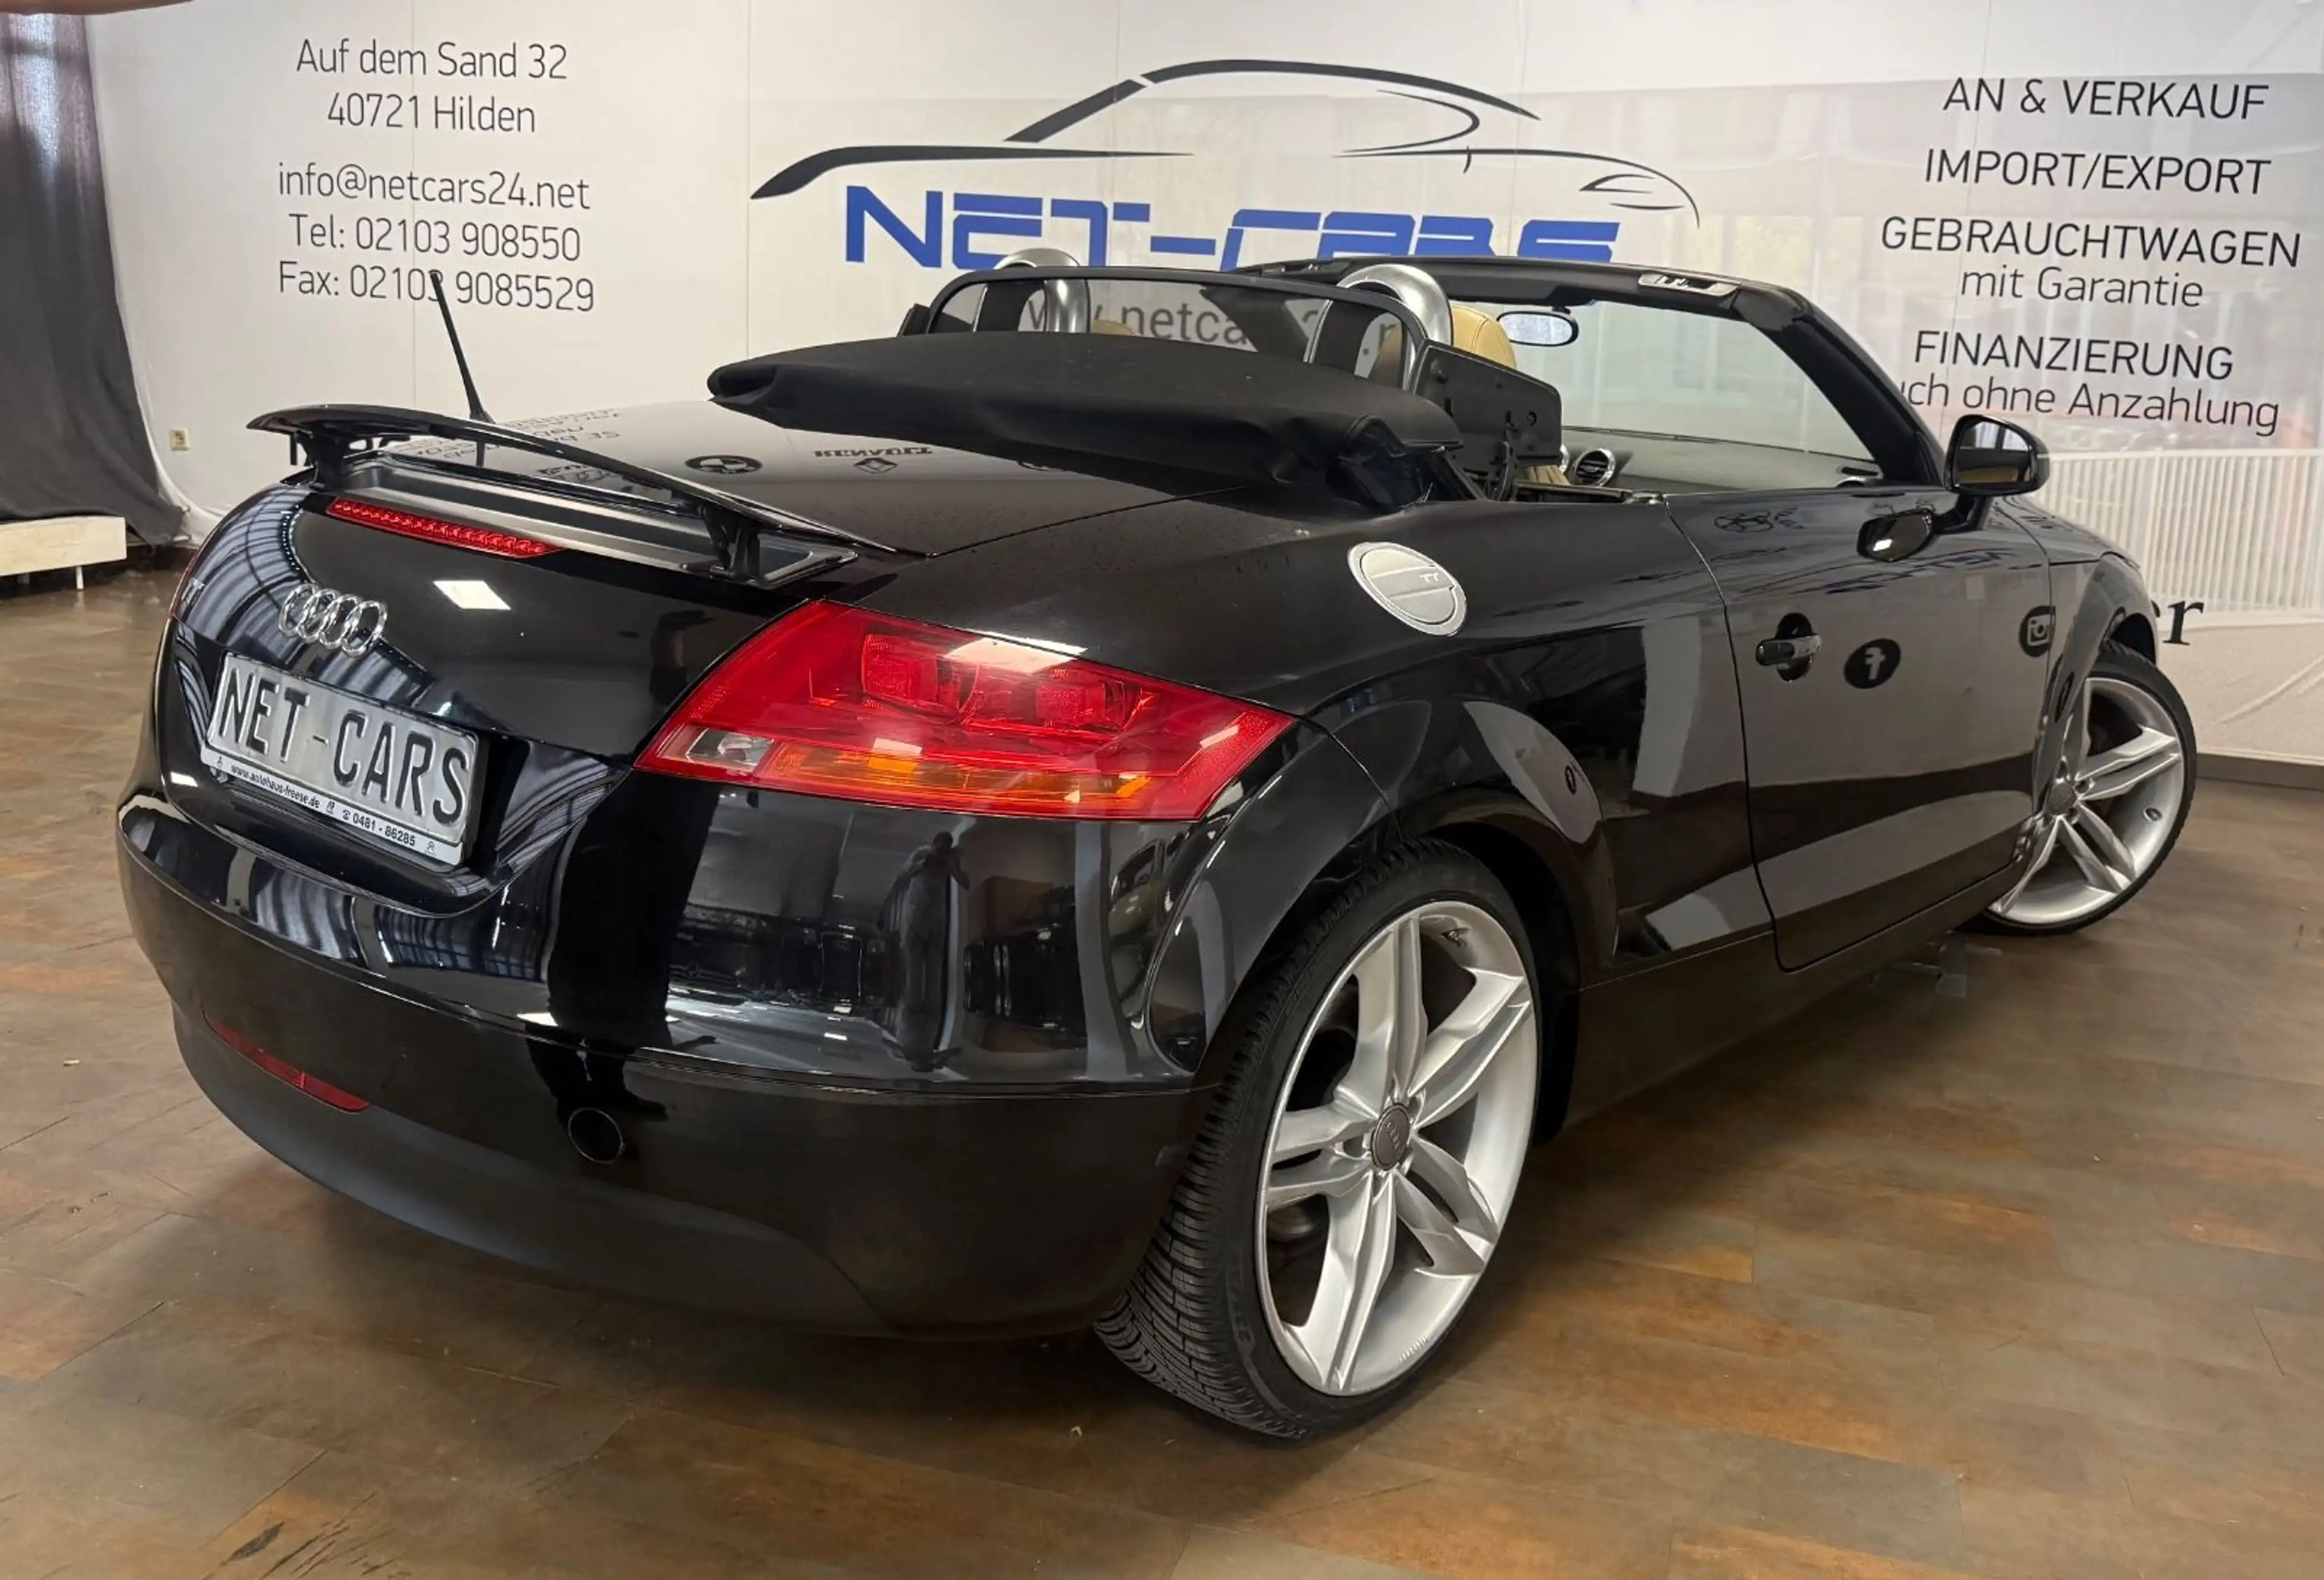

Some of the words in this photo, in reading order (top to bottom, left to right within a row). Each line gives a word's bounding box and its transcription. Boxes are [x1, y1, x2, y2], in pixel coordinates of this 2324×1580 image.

[297, 38, 349, 73] Auf
[359, 38, 426, 75] dem
[438, 42, 517, 77] Sand
[528, 44, 568, 79] 32
[327, 93, 419, 128] 40721
[434, 95, 536, 133] Hilden
[1943, 77, 2005, 112] AN
[2020, 78, 2046, 114] &
[2062, 79, 2270, 120] VERKAUF
[278, 162, 591, 209] info@netcars24.net
[1925, 148, 2272, 195] IMPORT/EXPORT
[289, 213, 345, 249] Tel:
[355, 216, 451, 254] 02103
[462, 221, 580, 261] 908550
[1881, 215, 2301, 268] GEBRAUCHTWAGEN
[280, 260, 340, 296] Fax:
[349, 264, 444, 303] 02103
[456, 270, 594, 312] 9085529
[1960, 264, 2025, 300] mit
[2037, 266, 2204, 307] Garantie
[1914, 330, 2234, 380] FINANZIERUNG
[1901, 372, 1949, 407] ch
[1962, 375, 2056, 413] ohne
[2067, 382, 2280, 437] Anzahlung
[2150, 600, 2204, 646] r
